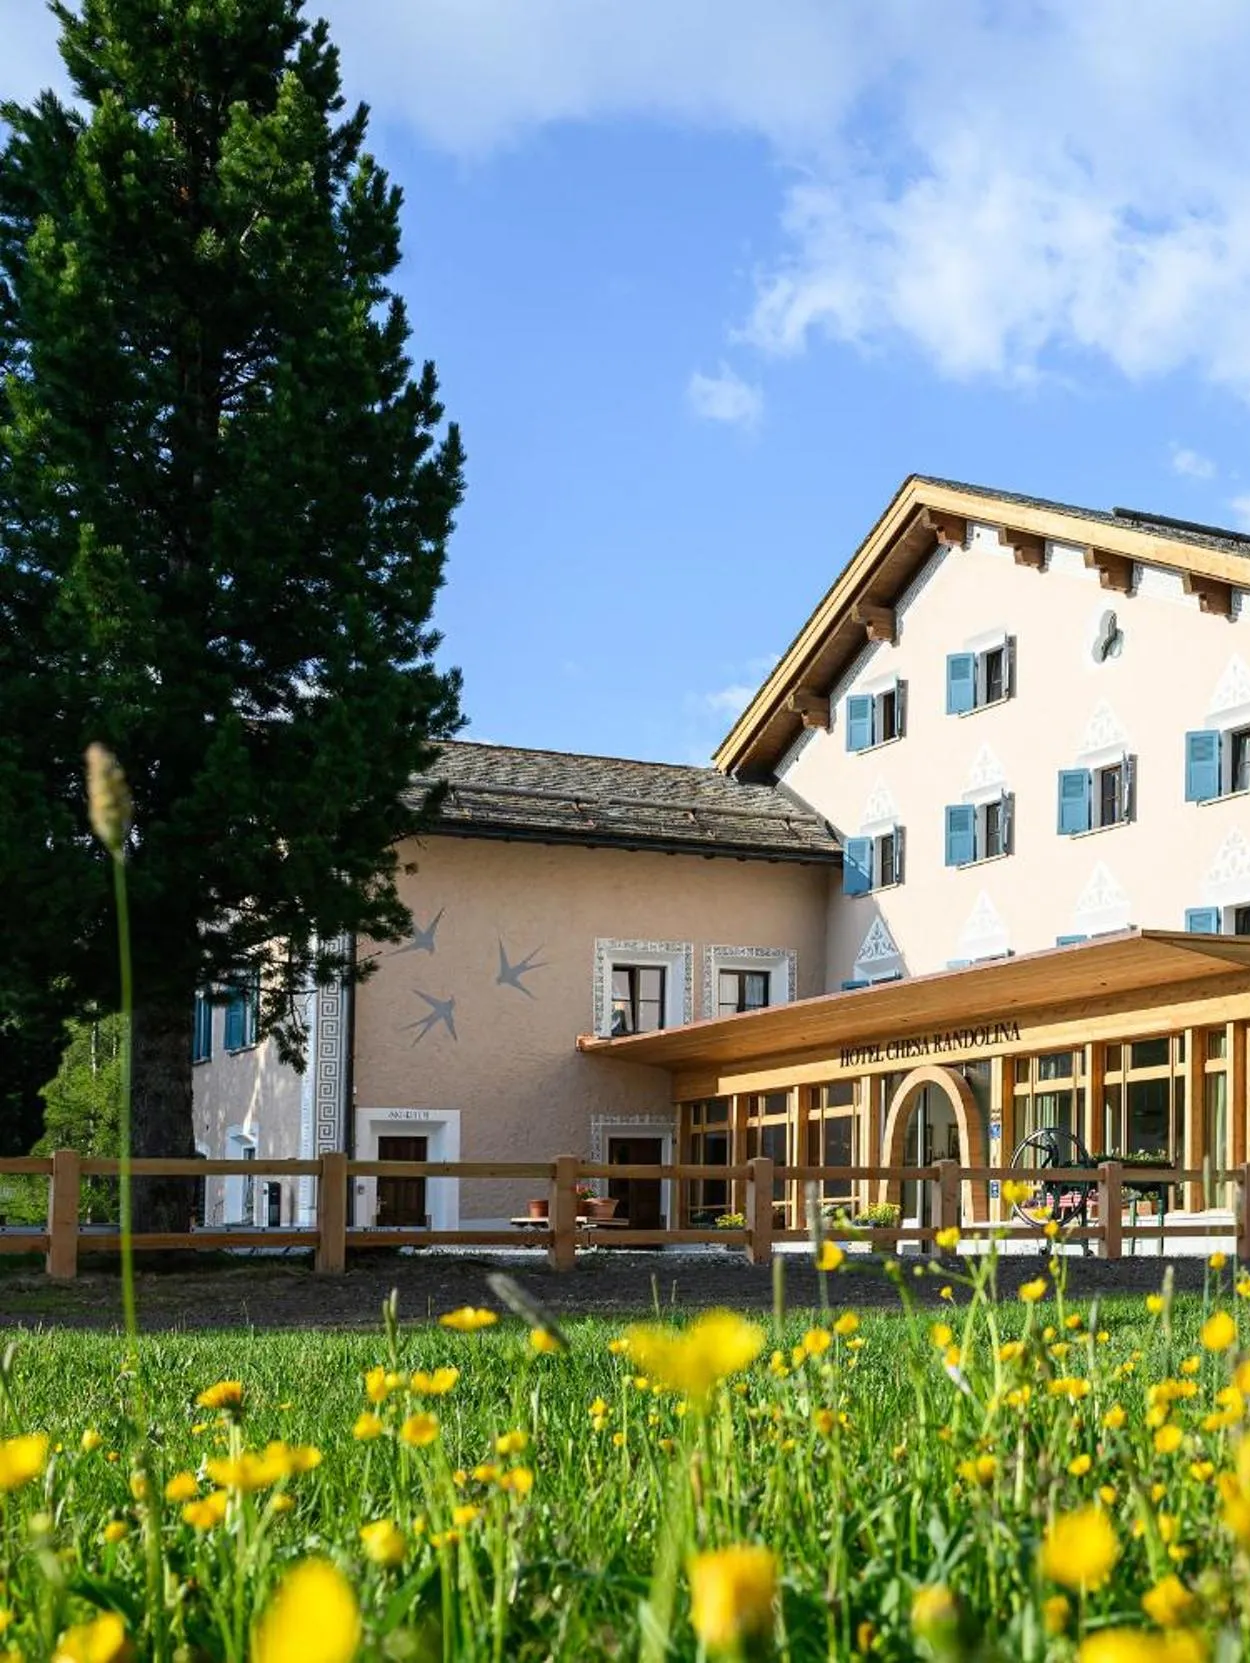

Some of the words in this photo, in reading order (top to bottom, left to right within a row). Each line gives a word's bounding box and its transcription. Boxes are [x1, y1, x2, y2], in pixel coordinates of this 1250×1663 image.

[839, 1043, 884, 1068] HOTEL
[886, 1036, 930, 1061] CHESA
[933, 1020, 1021, 1054] RANDOLINA
